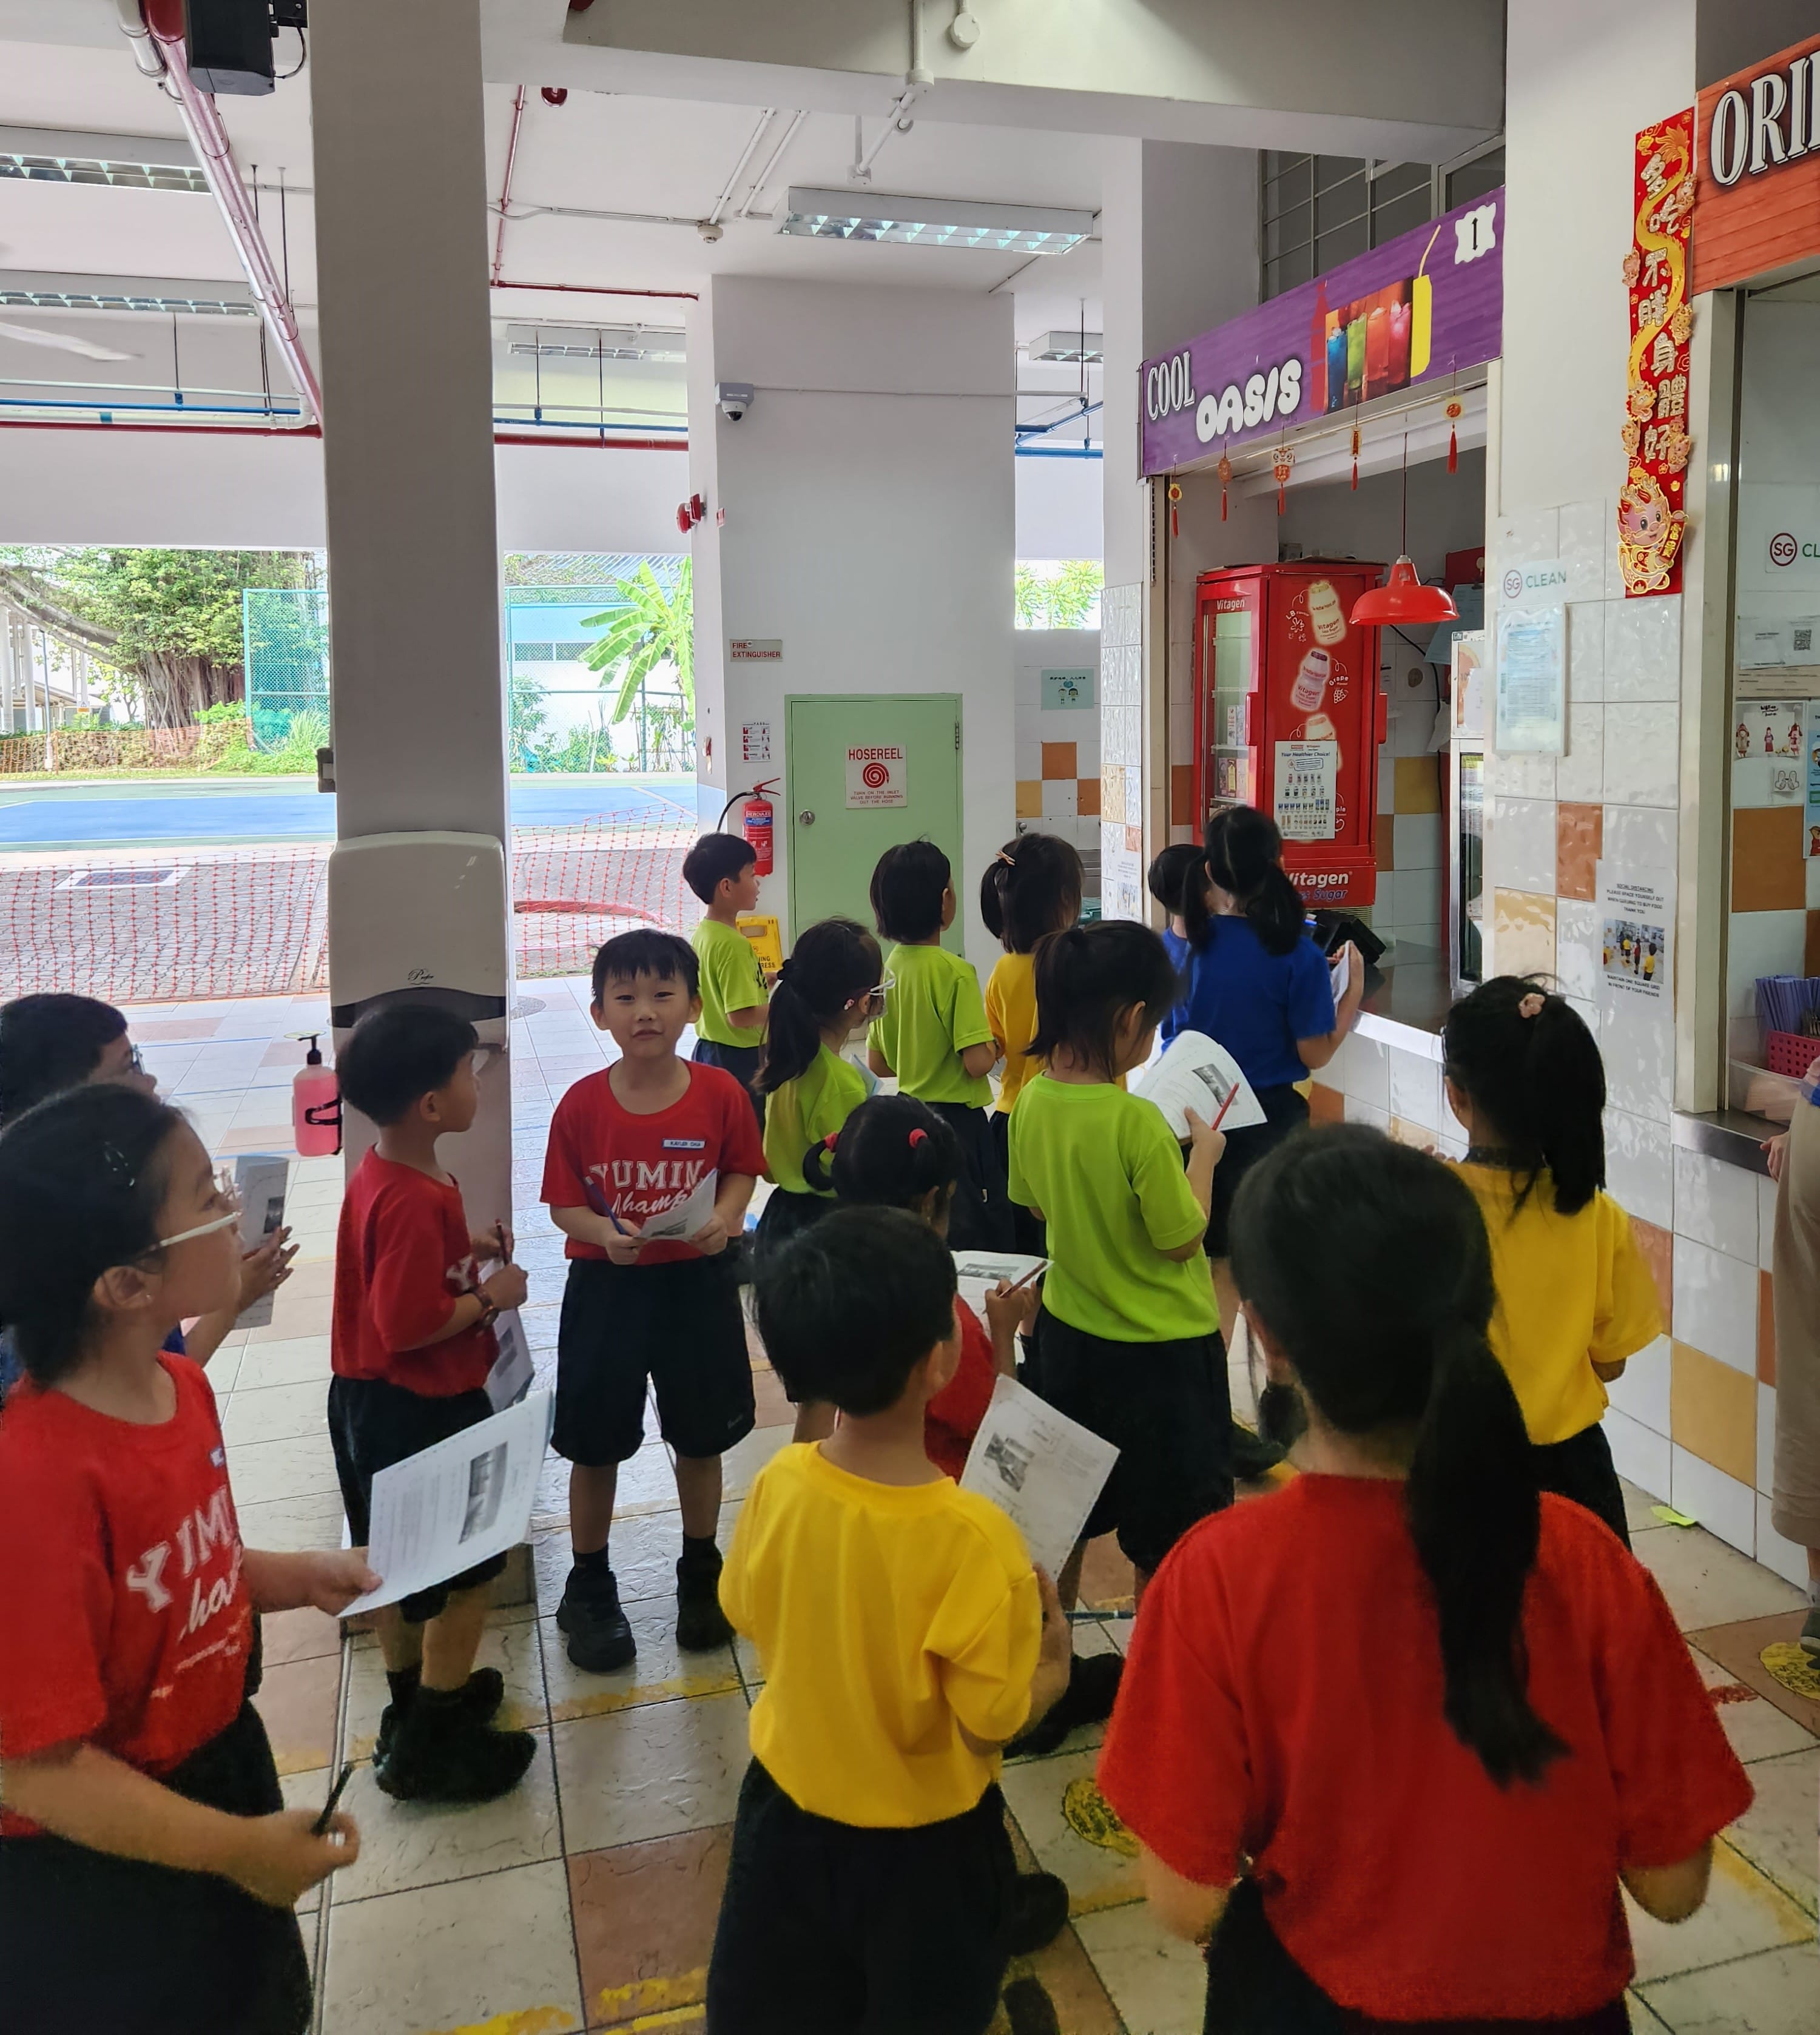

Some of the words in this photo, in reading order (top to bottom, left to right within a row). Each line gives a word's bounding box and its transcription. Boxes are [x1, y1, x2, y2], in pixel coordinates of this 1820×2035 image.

[1147, 351, 1195, 420] COOL
[1196, 358, 1302, 443] OASIS
[1773, 542, 1794, 556] SG
[1802, 543, 1820, 557] CL
[1506, 577, 1520, 591] SG
[1526, 571, 1566, 588] CLEAN
[1216, 599, 1245, 611] Vitagen
[1317, 619, 1340, 630] Vitagen
[1329, 676, 1349, 685] Grape
[1298, 684, 1320, 696] Vitagen
[849, 748, 903, 761] HOSEREEL
[1313, 889, 1348, 902] Sugar
[589, 1159, 705, 1190] YUMIN
